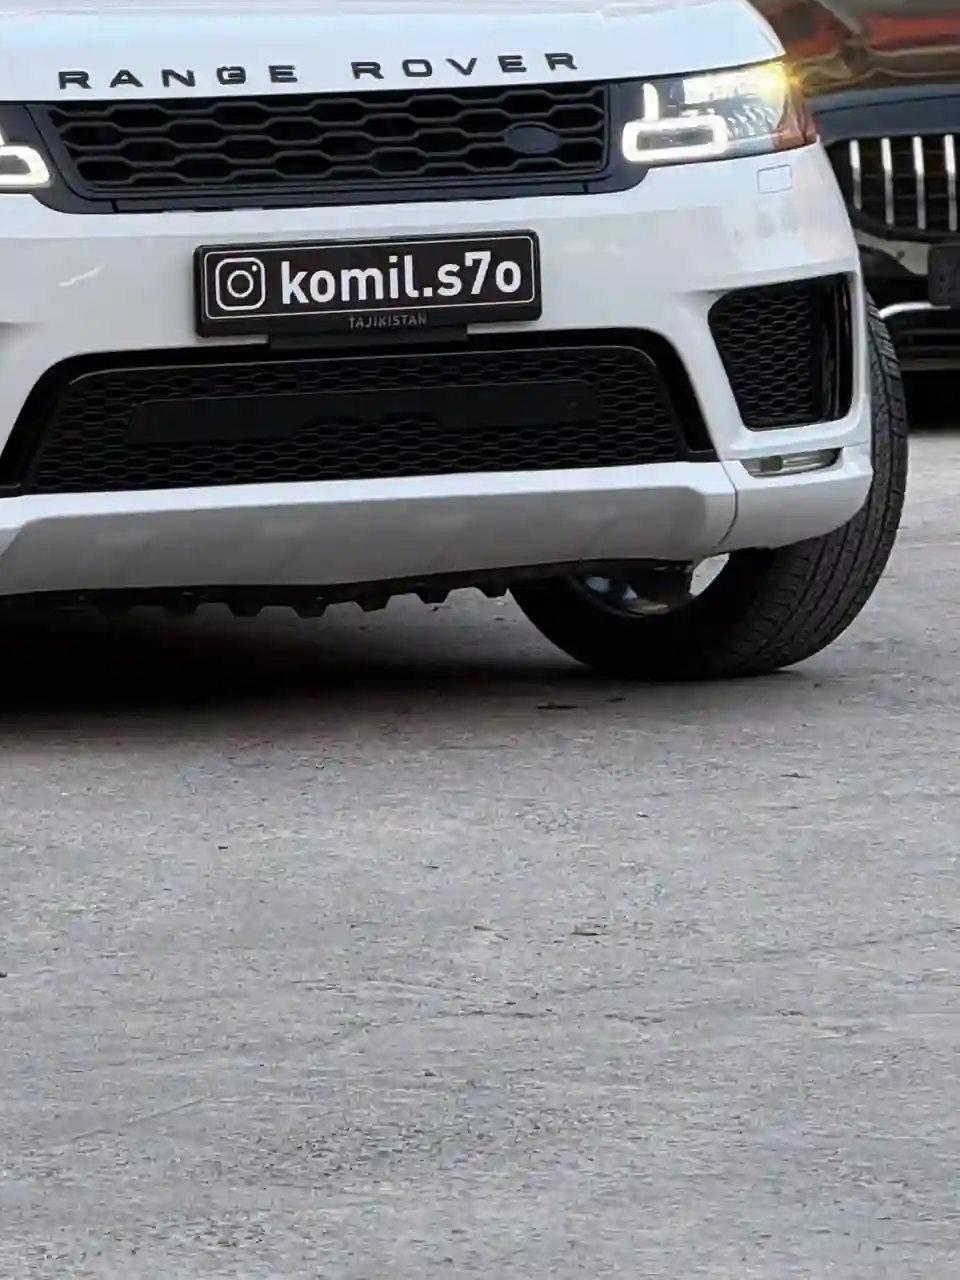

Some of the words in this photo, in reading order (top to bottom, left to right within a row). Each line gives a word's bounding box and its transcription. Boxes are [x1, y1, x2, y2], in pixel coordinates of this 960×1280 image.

[57, 64, 300, 91] RANGE
[350, 51, 579, 81] ROVER
[280, 250, 522, 305] komil.s7o
[348, 314, 428, 329] TAJIKISTAN
